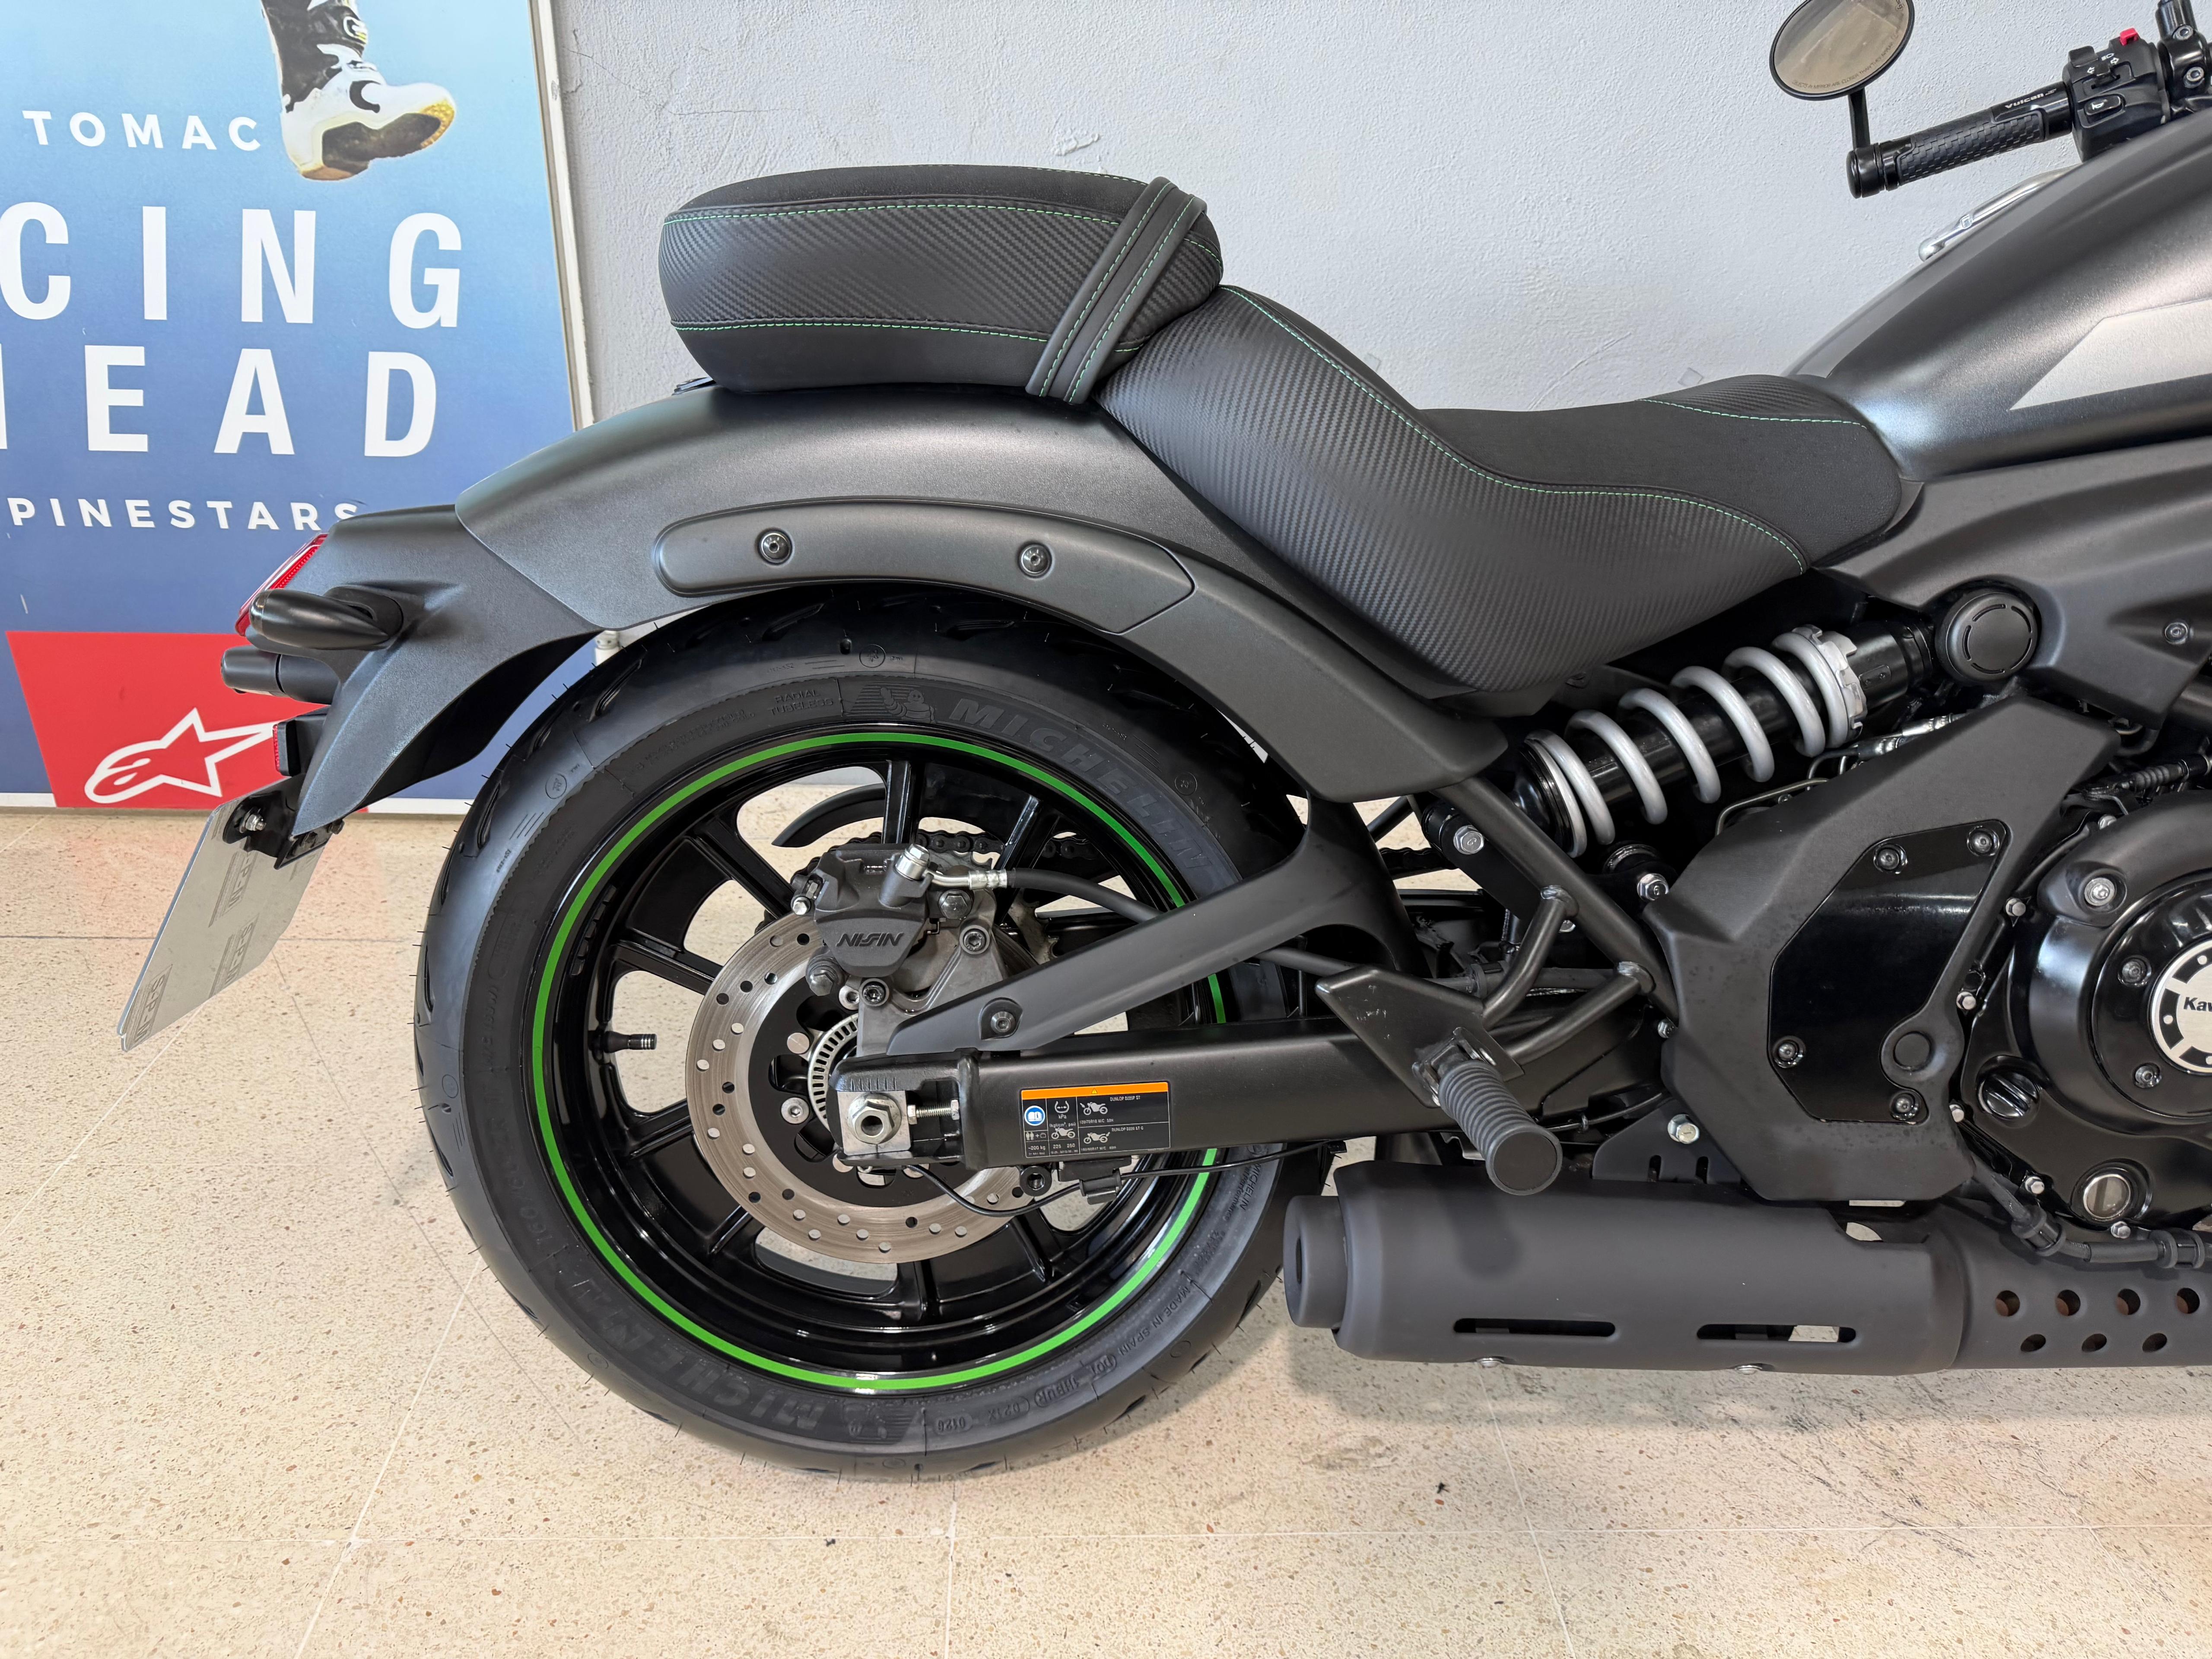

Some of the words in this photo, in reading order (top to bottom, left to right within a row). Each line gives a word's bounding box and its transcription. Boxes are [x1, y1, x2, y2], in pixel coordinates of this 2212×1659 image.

[22, 110, 261, 151] TOMAC
[0, 201, 462, 329] CING
[0, 343, 436, 457] EAD
[948, 697, 1212, 874] MICHELIN
[1239, 1163, 1262, 1212] MICHELIN
[1152, 1314, 1164, 1329] IN
[1165, 1285, 1191, 1317] MADE
[1119, 1327, 1150, 1356] SPAIN
[1091, 1355, 1114, 1375] DOT
